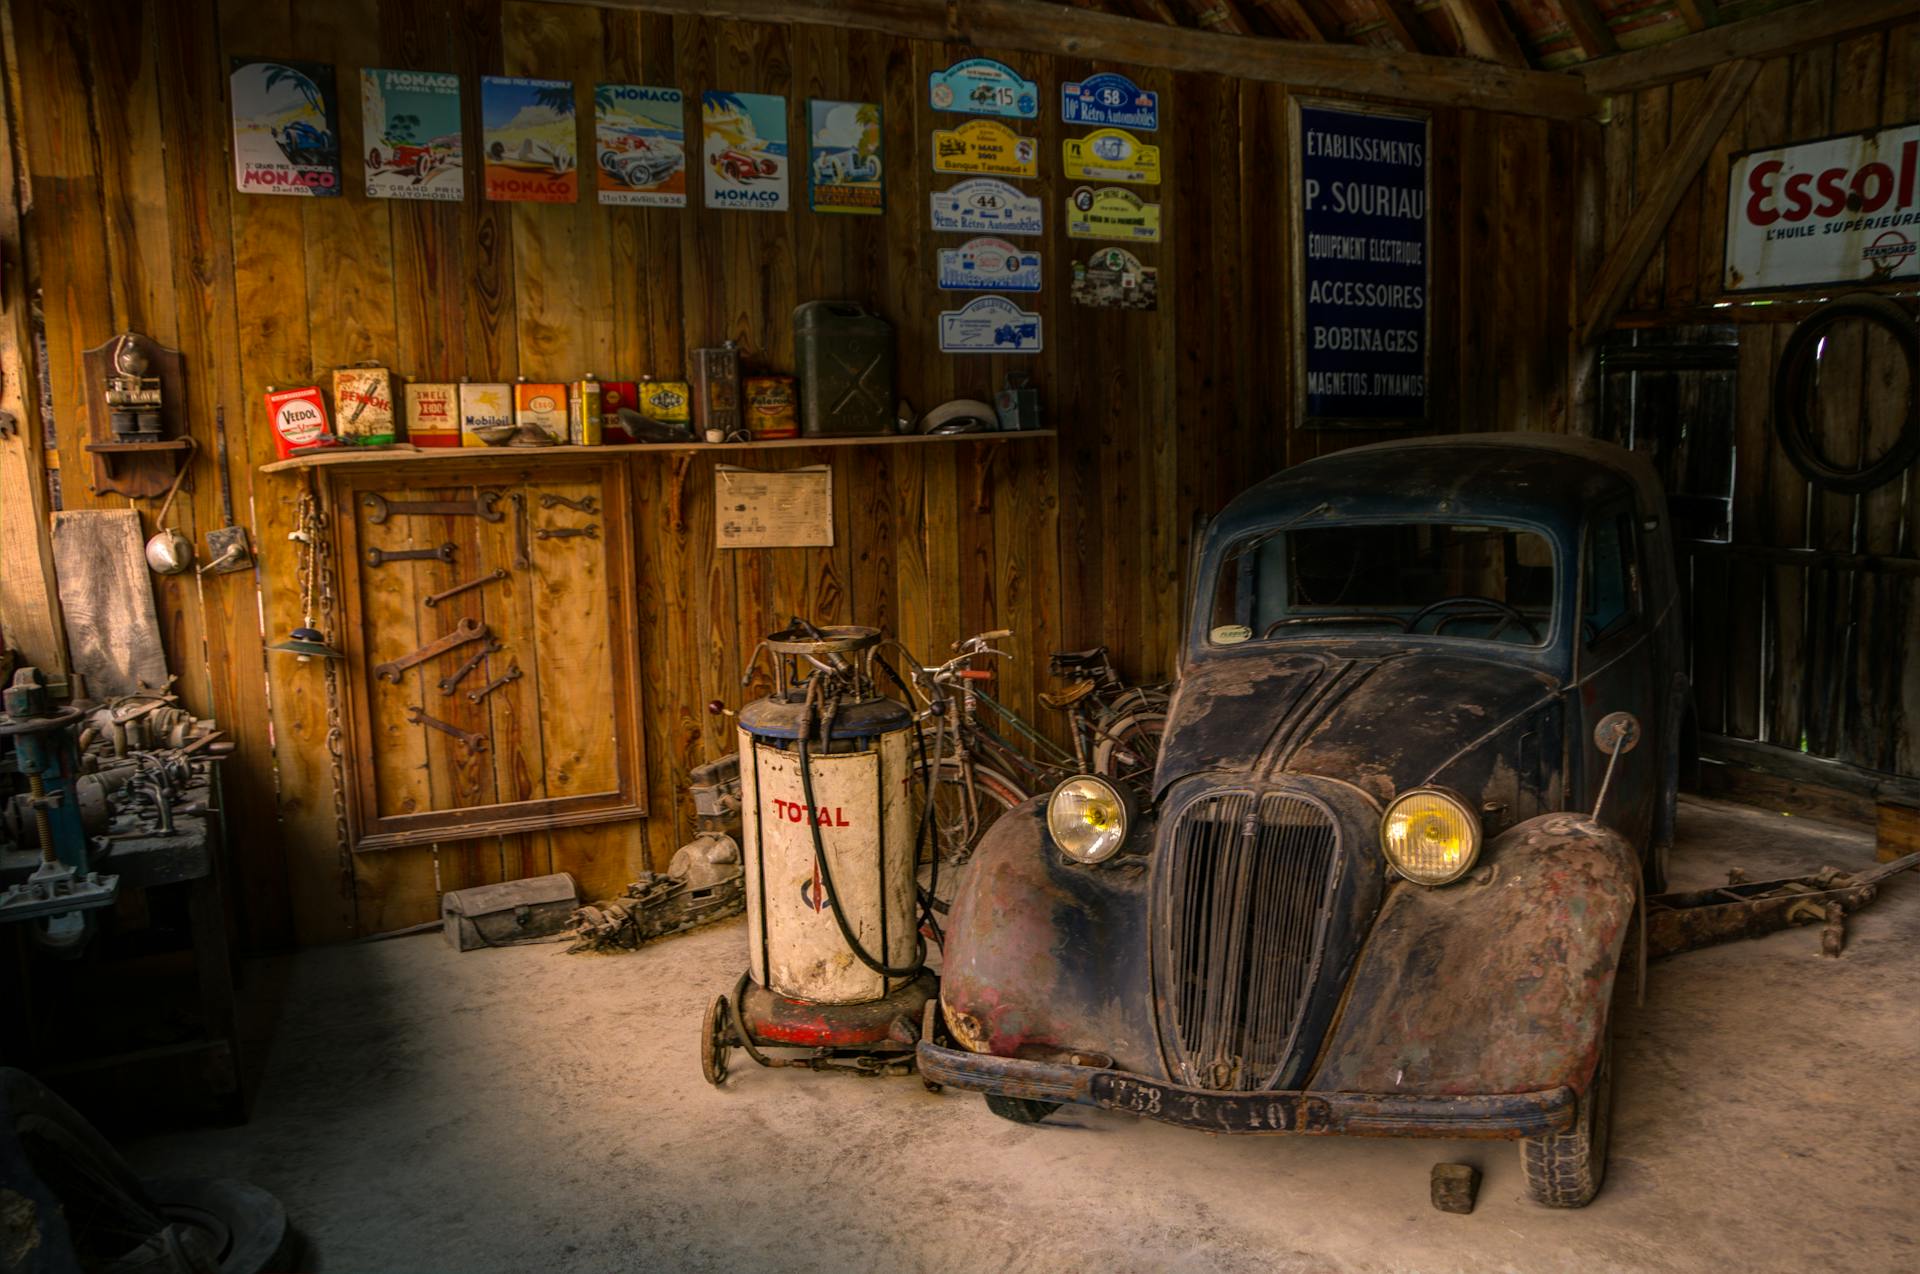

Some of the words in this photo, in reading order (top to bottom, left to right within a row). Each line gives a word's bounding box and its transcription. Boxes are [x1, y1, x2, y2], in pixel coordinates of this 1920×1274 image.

[385, 71, 460, 88] MONACO
[395, 85, 431, 93] AVRIL
[614, 88, 681, 103] MONACO
[997, 88, 1013, 106] 15
[1103, 89, 1121, 106] 58
[1081, 102, 1105, 122] Rétro
[1107, 107, 1156, 127] Automobiles
[977, 145, 1004, 153] MARS
[1307, 128, 1423, 168] ÉTABLISSEMENTS
[944, 160, 979, 172] Banque
[243, 169, 336, 189] MONACO
[491, 180, 571, 194] MONACO
[389, 184, 429, 192] GRAND
[434, 186, 462, 194] PRIX
[391, 192, 462, 200] AUTOMOBILE
[714, 189, 780, 202] MONACO
[976, 195, 998, 208] 44
[1305, 178, 1328, 211] P.
[1331, 180, 1424, 220] SOURIAU
[987, 216, 1041, 231] Automobiles
[1767, 225, 1816, 241] L'HUILE
[1824, 212, 1920, 235] SUPÉRIEURE
[1863, 243, 1916, 257] STANDARD
[1310, 279, 1423, 309] ACCESSOIRES
[1313, 326, 1418, 353] BOBINAGES
[1374, 373, 1424, 397] DYNAMOS
[416, 391, 448, 400] SHELL
[282, 409, 317, 426] VEEDOL
[466, 416, 510, 426] Mobiloil
[772, 798, 850, 828] TOTAL
